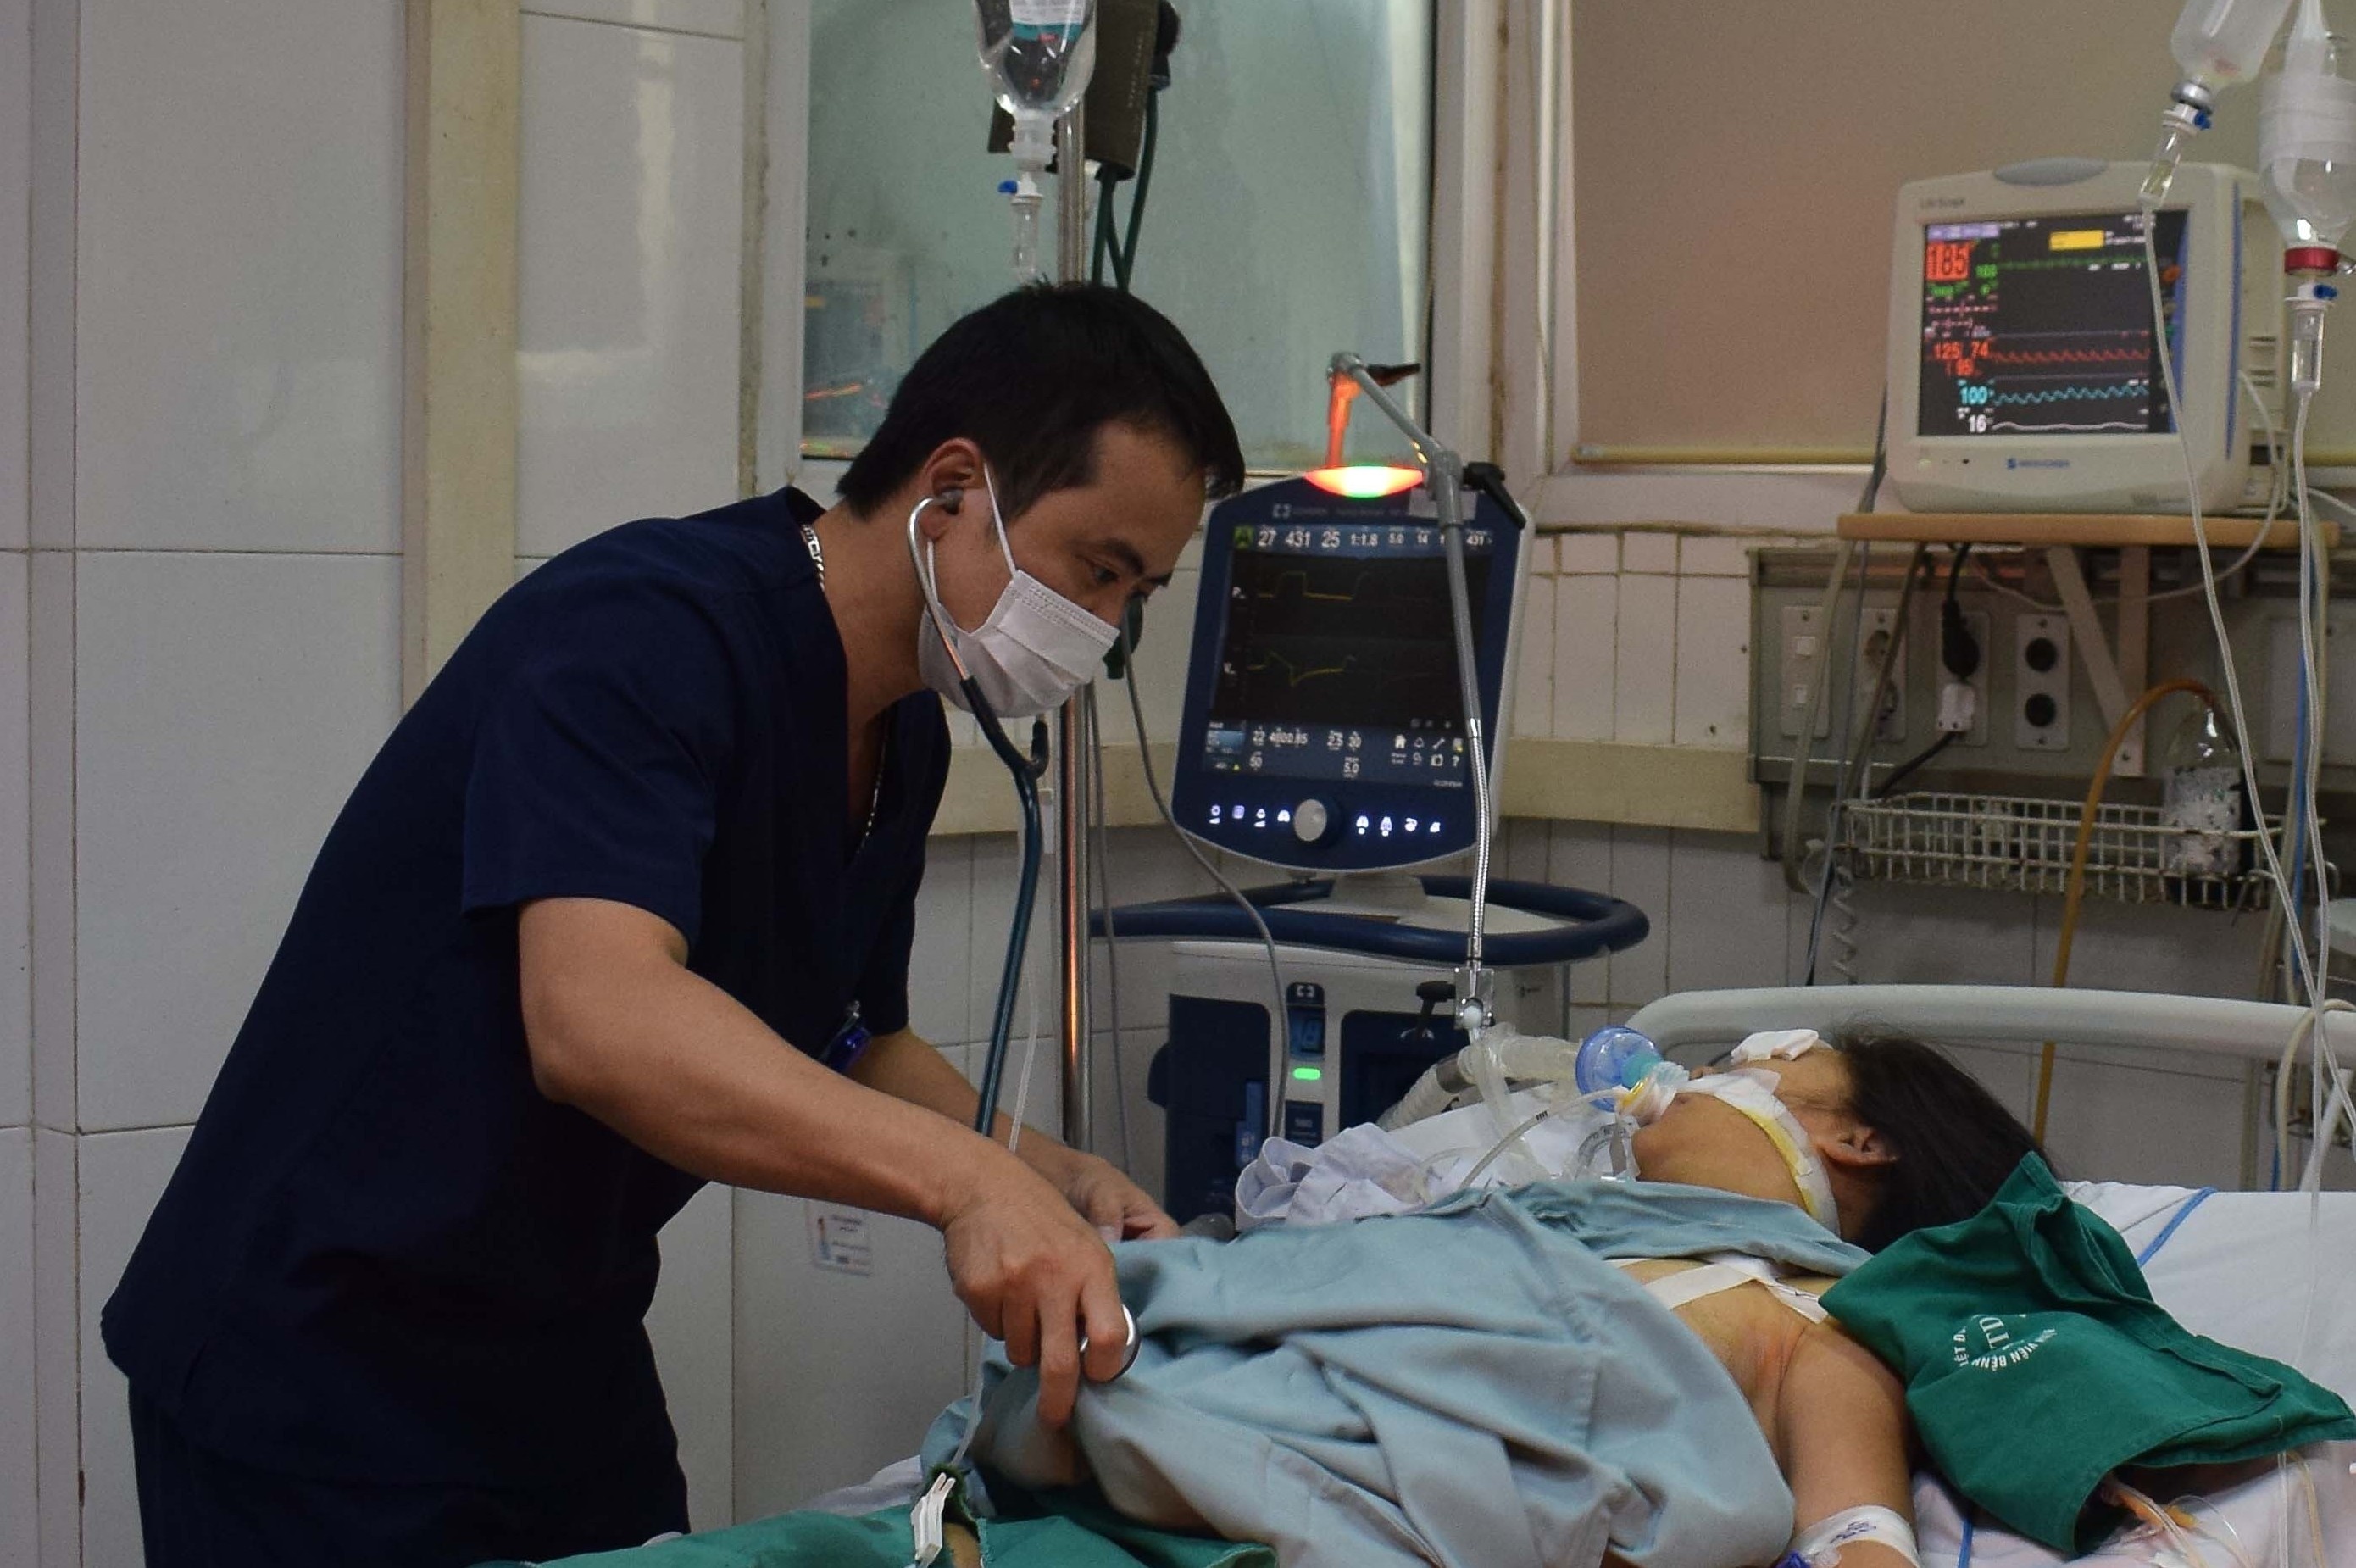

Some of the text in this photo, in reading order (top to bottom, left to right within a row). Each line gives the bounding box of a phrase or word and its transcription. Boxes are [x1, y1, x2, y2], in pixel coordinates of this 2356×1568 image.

[1960, 386, 1989, 405] 100
[1969, 414, 1988, 433] 16
[1258, 529, 1276, 548] 27
[1285, 531, 1311, 548] 431
